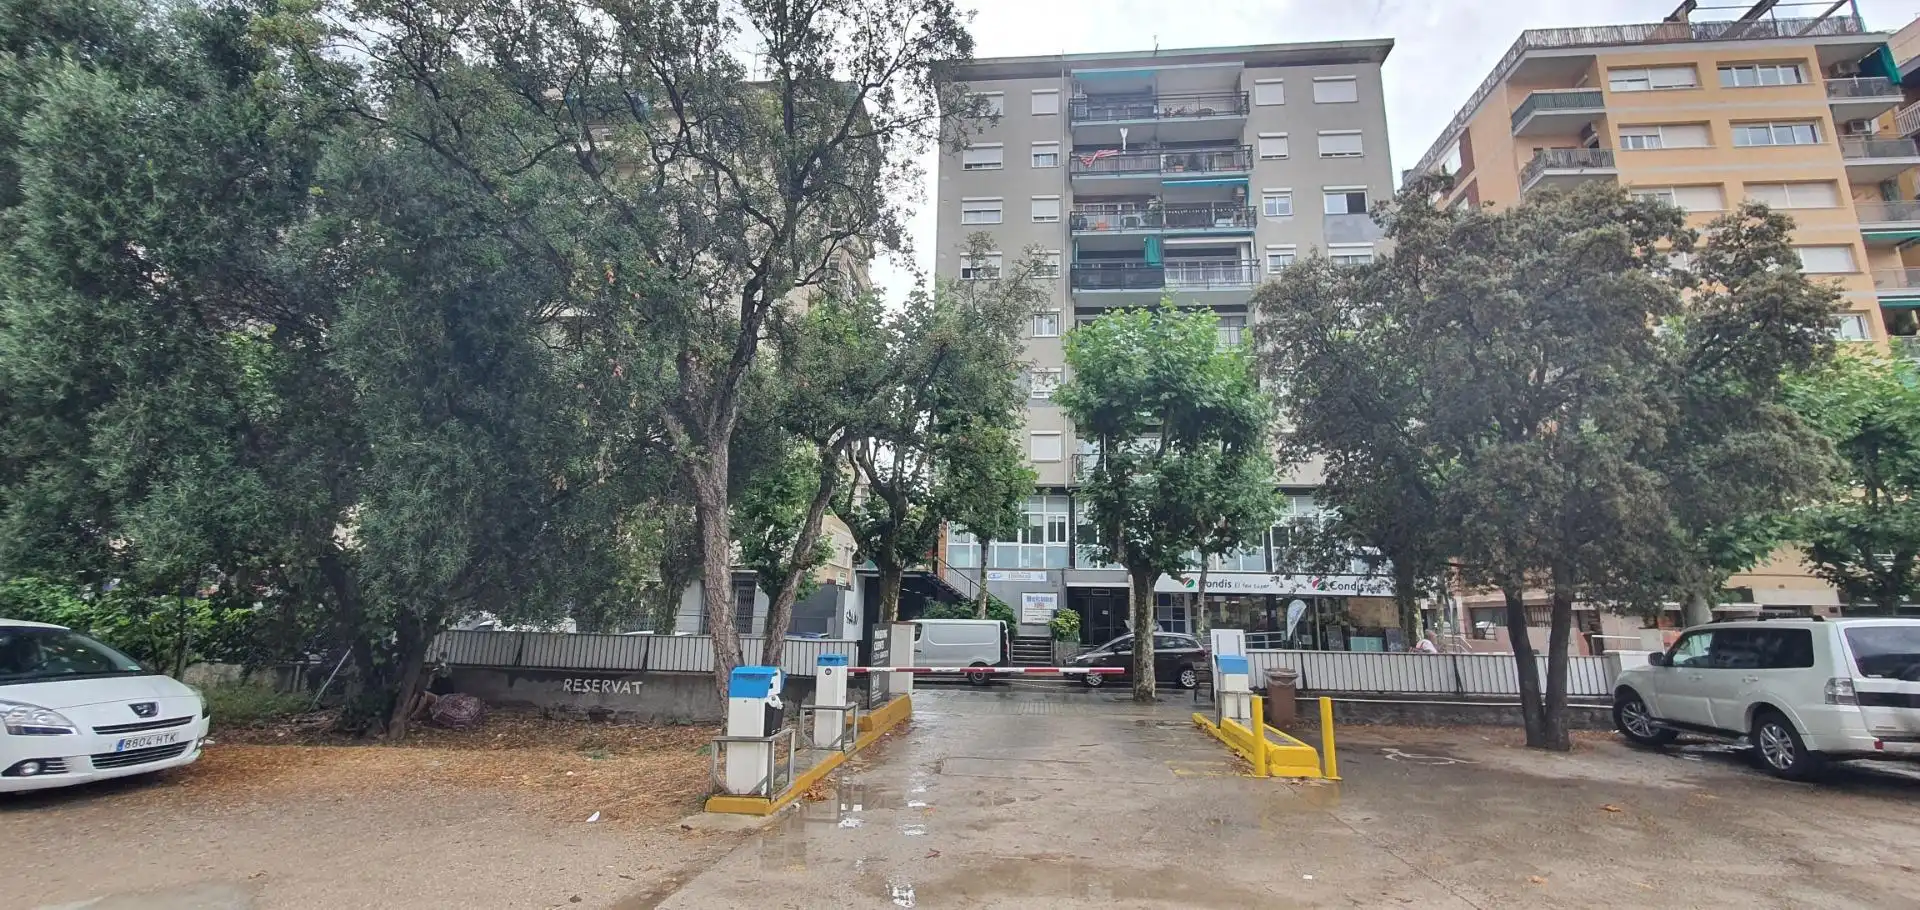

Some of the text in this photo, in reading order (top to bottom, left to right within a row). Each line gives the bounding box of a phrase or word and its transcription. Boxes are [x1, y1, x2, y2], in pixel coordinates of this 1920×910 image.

[1199, 579, 1232, 589] ondis
[563, 678, 643, 695] RESERVAT
[125, 733, 176, 749] 8804 HTK
